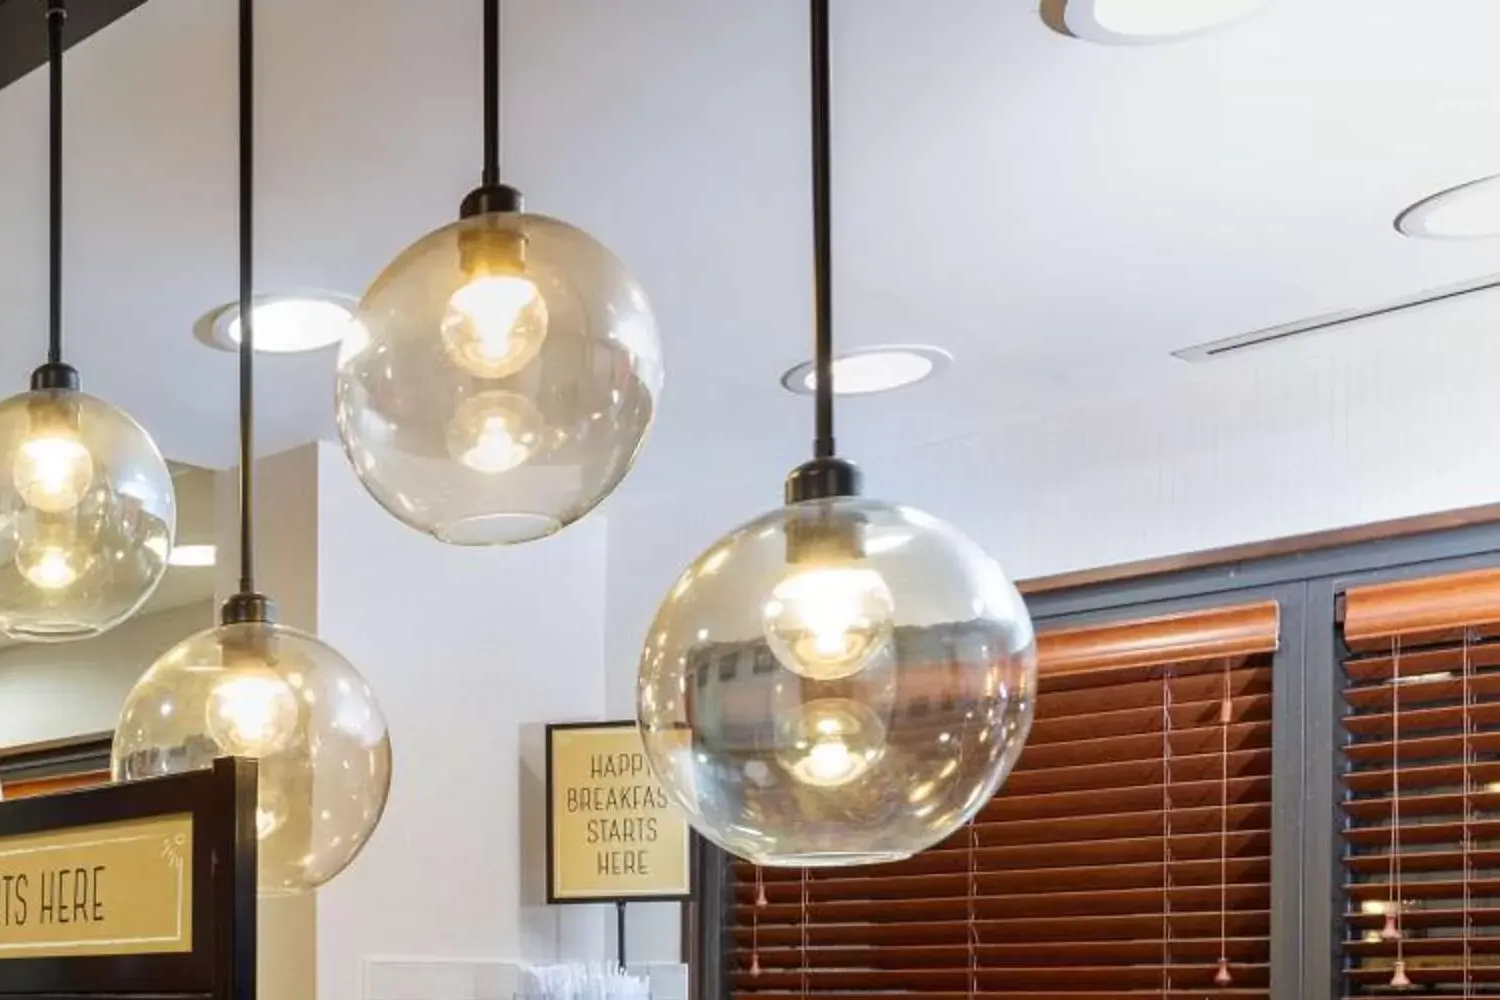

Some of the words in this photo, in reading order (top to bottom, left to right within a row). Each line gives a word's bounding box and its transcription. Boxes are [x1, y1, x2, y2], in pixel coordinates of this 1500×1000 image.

[590, 753, 651, 778] HAPP
[567, 785, 668, 813] BREAKFAS
[587, 817, 658, 843] STARTS
[597, 850, 650, 875] HERE
[40, 865, 106, 924] HERE
